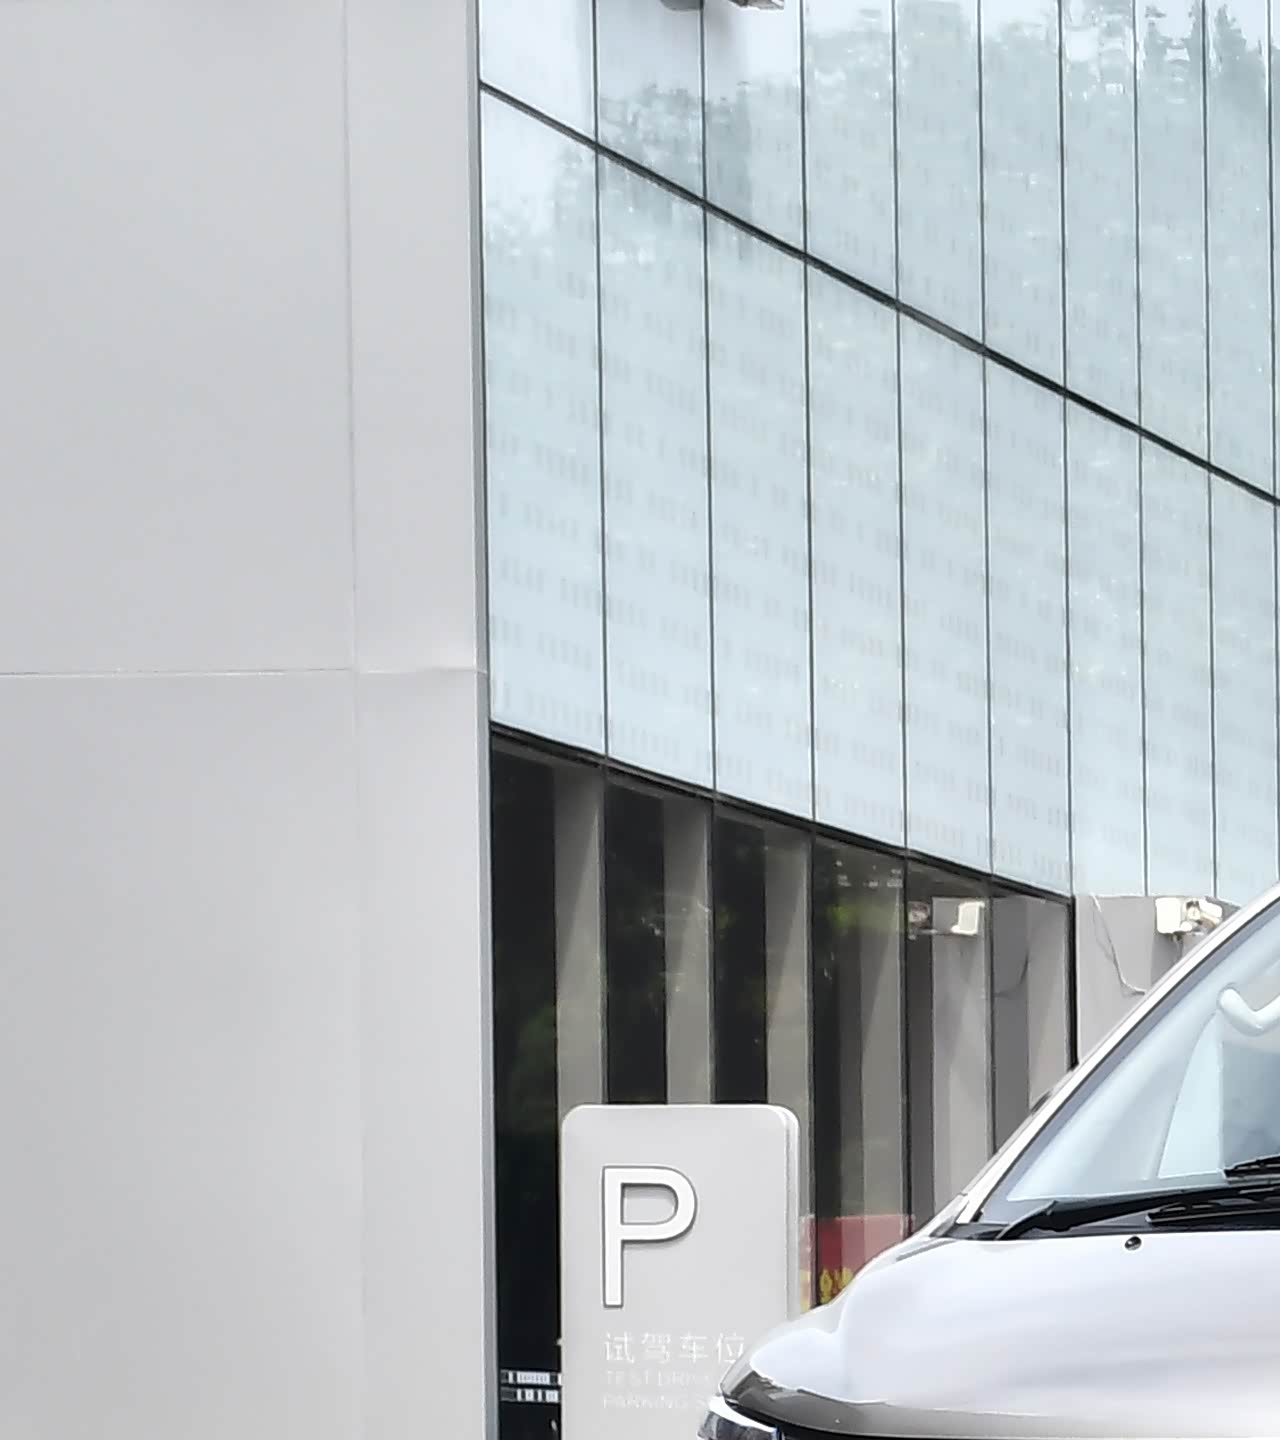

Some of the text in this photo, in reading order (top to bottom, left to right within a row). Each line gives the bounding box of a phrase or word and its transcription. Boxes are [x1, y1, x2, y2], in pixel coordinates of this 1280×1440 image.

[602, 1166, 698, 1308] P
[604, 1331, 745, 1363] 试驾车位
